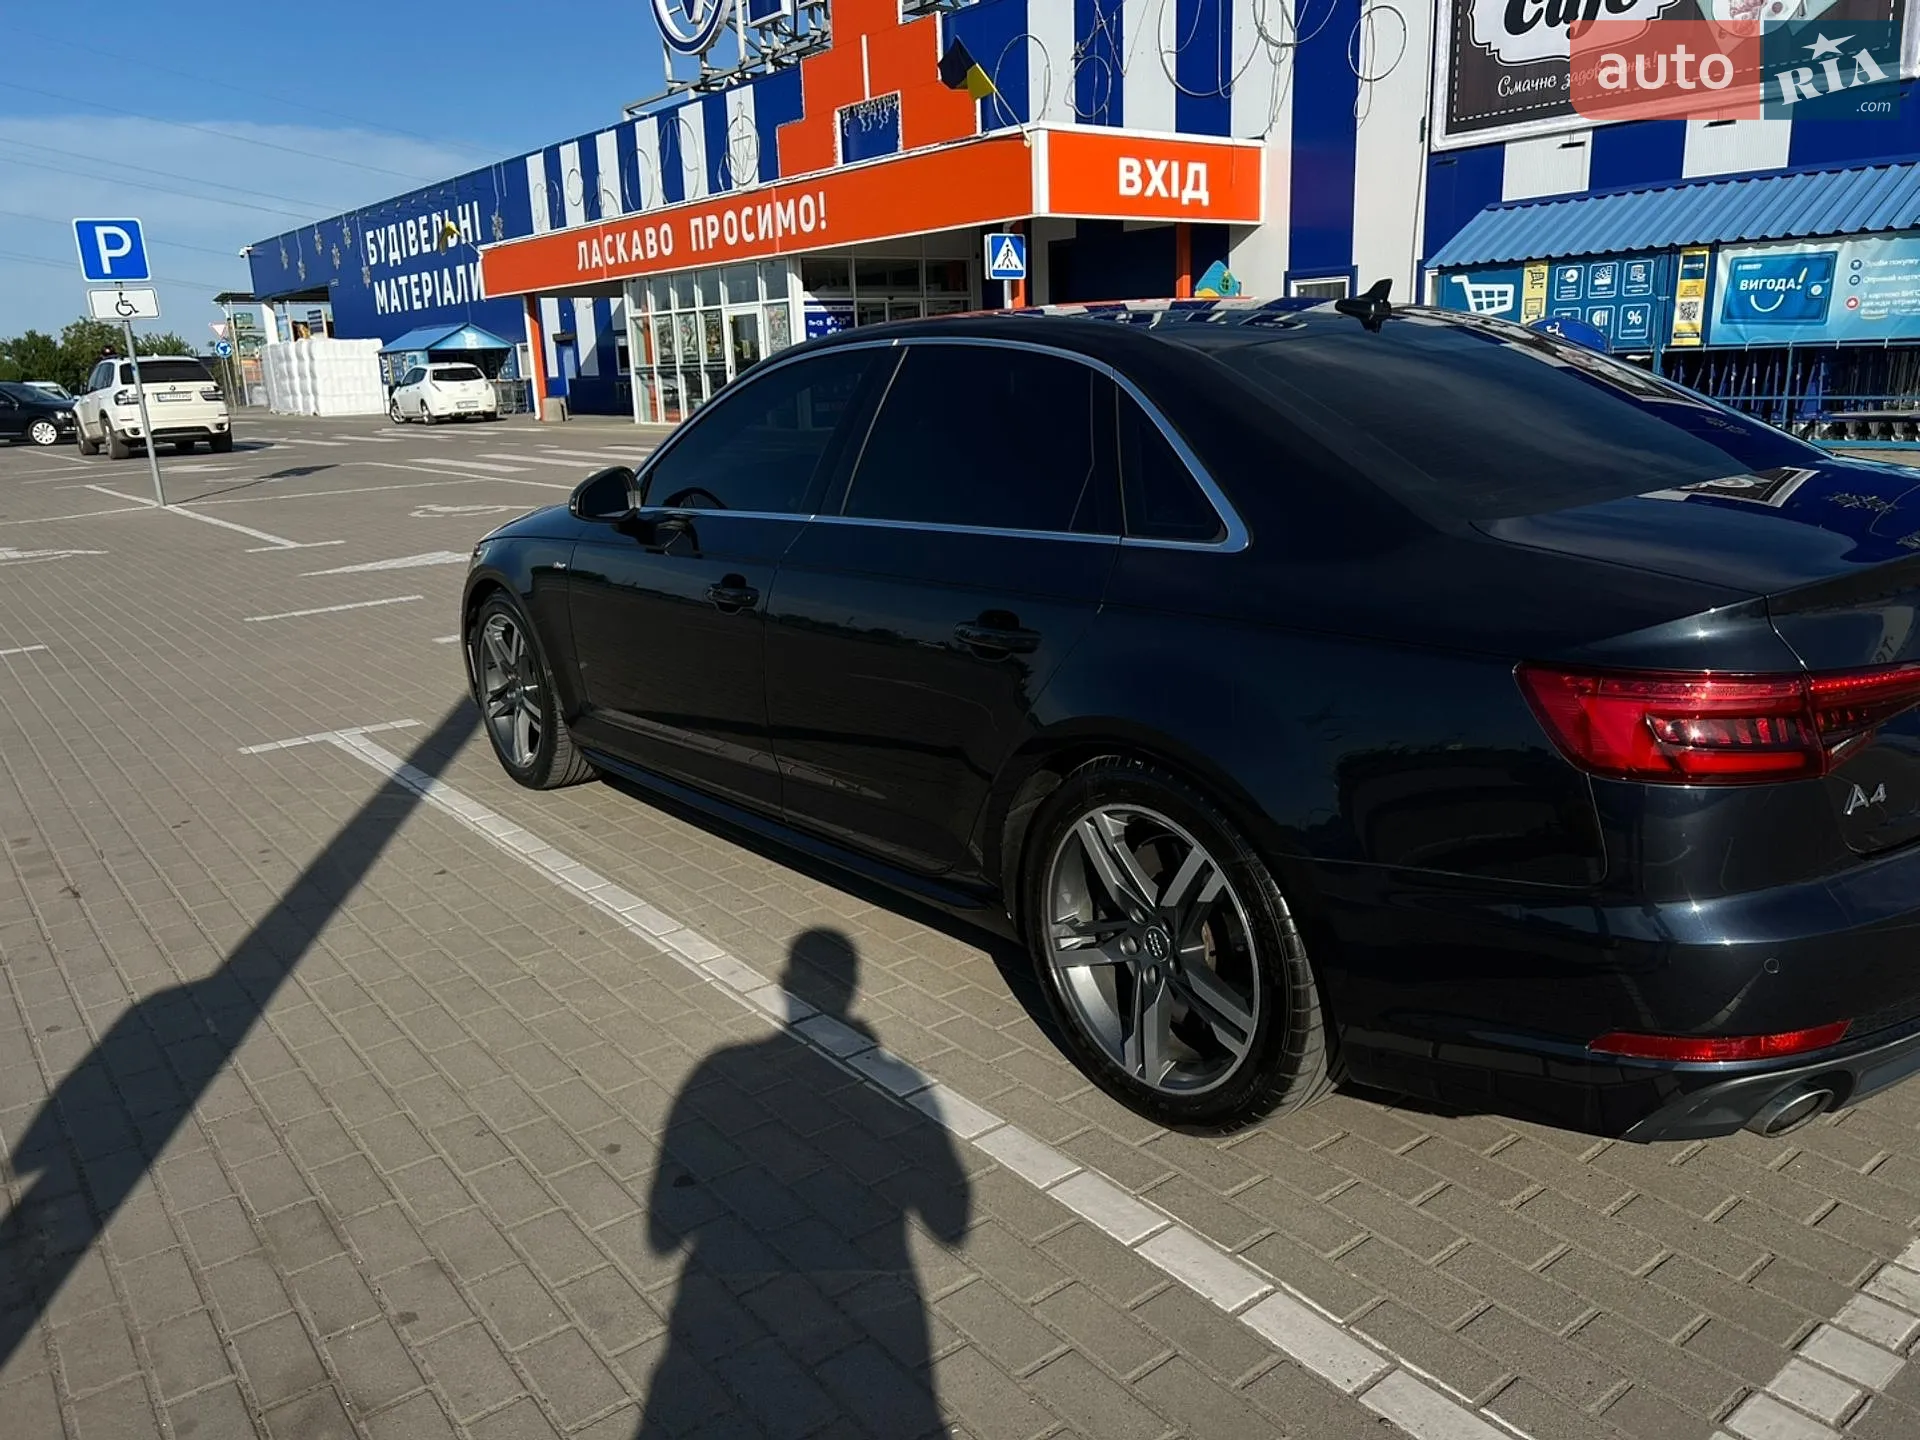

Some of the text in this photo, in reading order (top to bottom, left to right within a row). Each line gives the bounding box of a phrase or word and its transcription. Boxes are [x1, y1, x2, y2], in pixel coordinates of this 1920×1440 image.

[1497, 75, 1557, 98] Смачне
[1118, 156, 1210, 207] ВХІД
[94, 225, 132, 275] P
[365, 200, 482, 267] БУДІВЕЛЬНІ
[577, 191, 827, 271] ЛАСКАВО ПРОСИМО!
[373, 262, 482, 315] МАТЕРІАЛИ
[1739, 267, 1808, 292] ВИГОДА!
[1843, 783, 1887, 816] A4
